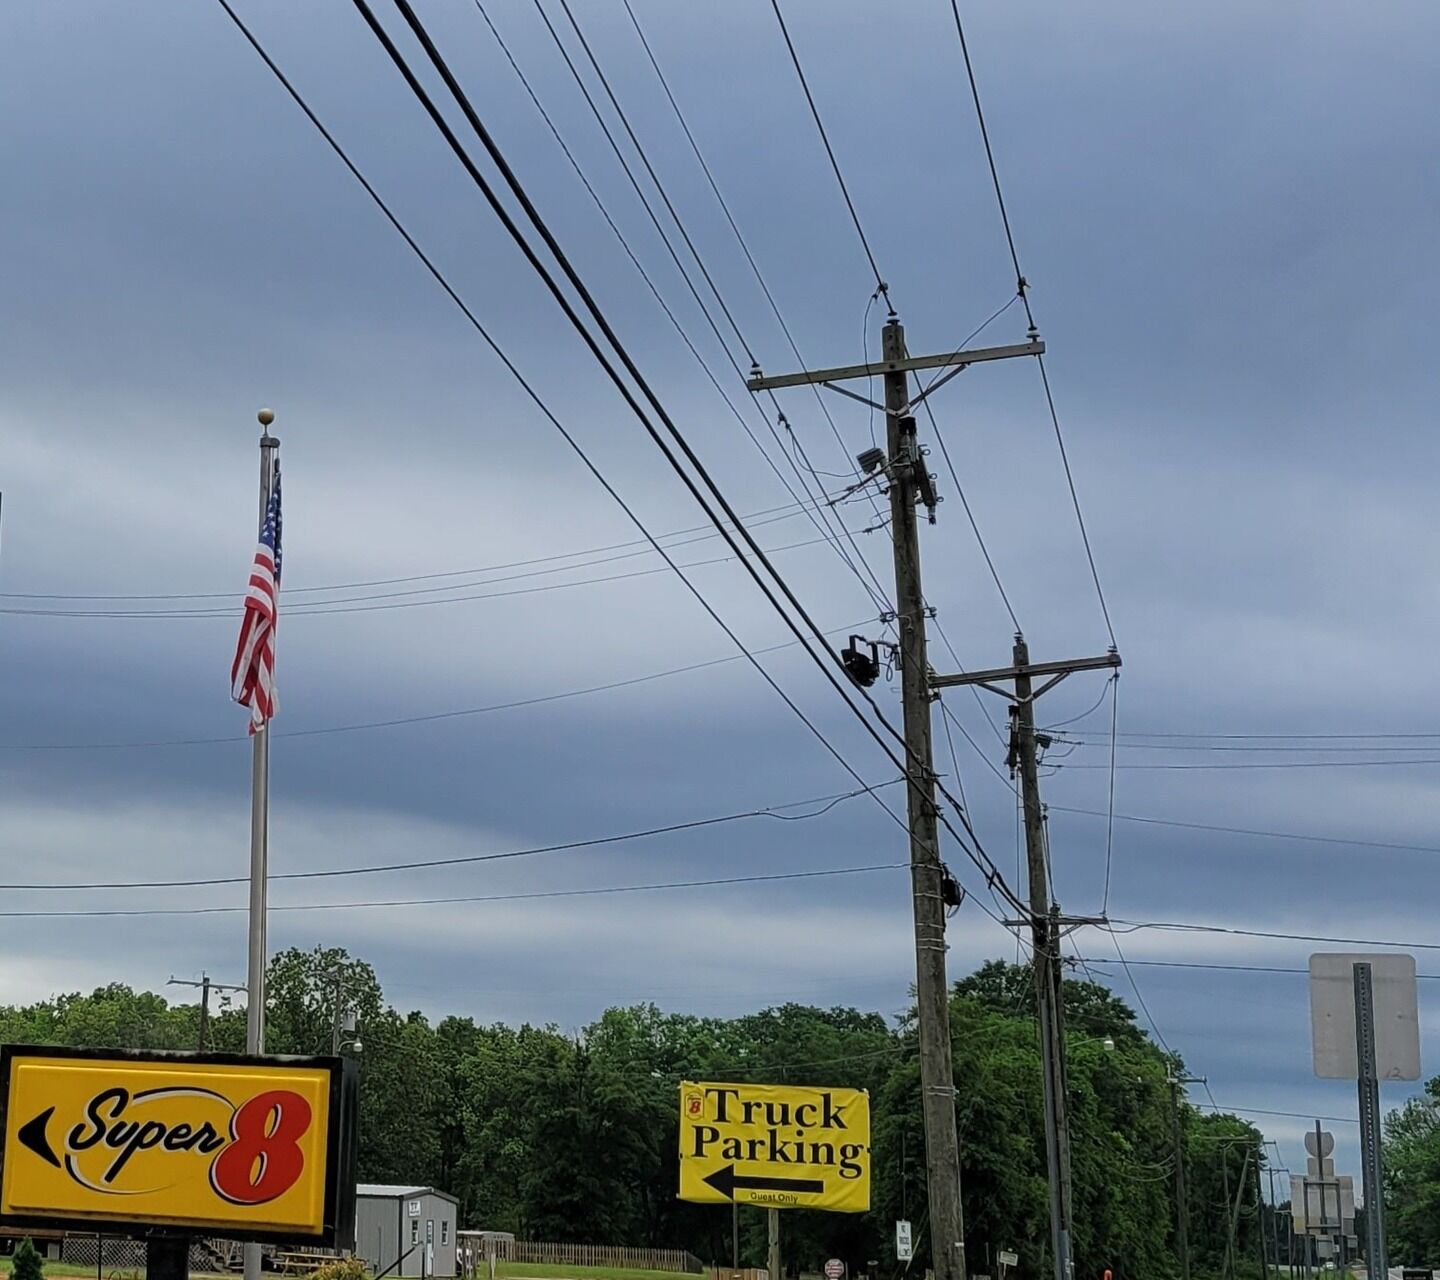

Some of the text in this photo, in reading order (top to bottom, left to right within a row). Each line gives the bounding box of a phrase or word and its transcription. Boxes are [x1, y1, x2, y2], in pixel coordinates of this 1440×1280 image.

[705, 1088, 848, 1129] Truck
[69, 1087, 311, 1206] Super 8
[691, 1125, 864, 1179] Parking
[750, 1192, 799, 1205] Guest Only
